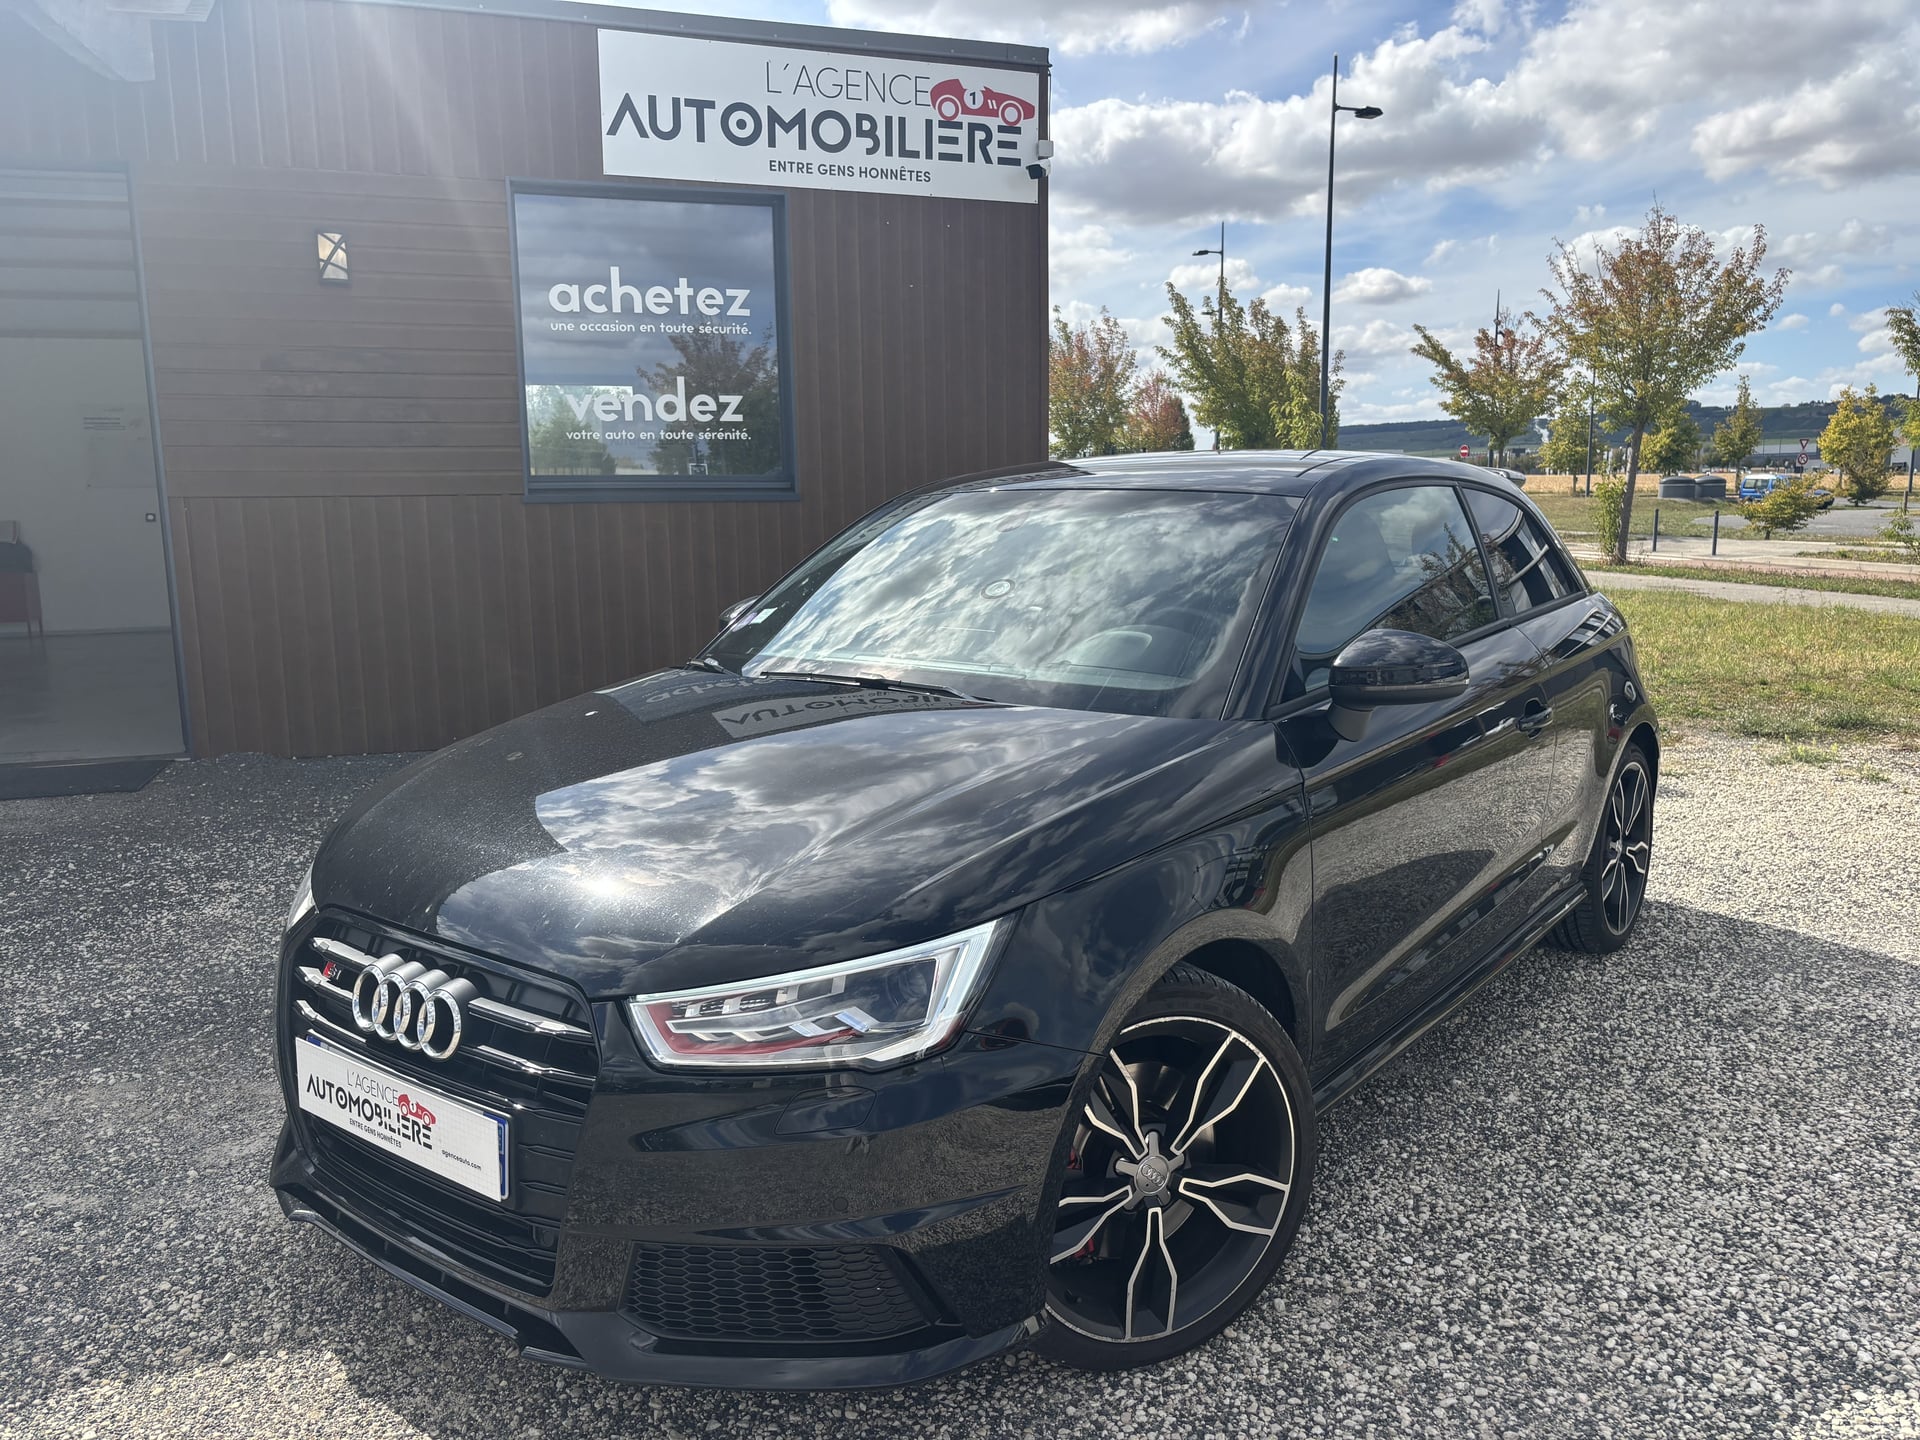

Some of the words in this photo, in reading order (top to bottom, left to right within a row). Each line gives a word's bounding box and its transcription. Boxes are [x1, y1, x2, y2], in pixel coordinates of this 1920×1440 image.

[766, 61, 930, 107] L'AGENCE
[970, 91, 976, 106] 1
[769, 159, 813, 175] ENTRE
[818, 163, 855, 178] GENS
[859, 165, 931, 183] HONNÊTES
[548, 266, 751, 316] achetez
[550, 322, 575, 331] une
[579, 320, 635, 332] occasion
[639, 323, 655, 332] en
[660, 322, 694, 333] toute
[698, 320, 752, 335] sécurité.
[566, 376, 744, 422] vendez
[566, 430, 600, 440] votre
[605, 429, 635, 440] auto
[639, 431, 655, 440] en
[660, 429, 694, 440] toute
[698, 427, 752, 440] sérénité.
[349, 1118, 364, 1131] ENTRE
[363, 1124, 377, 1137] GENS
